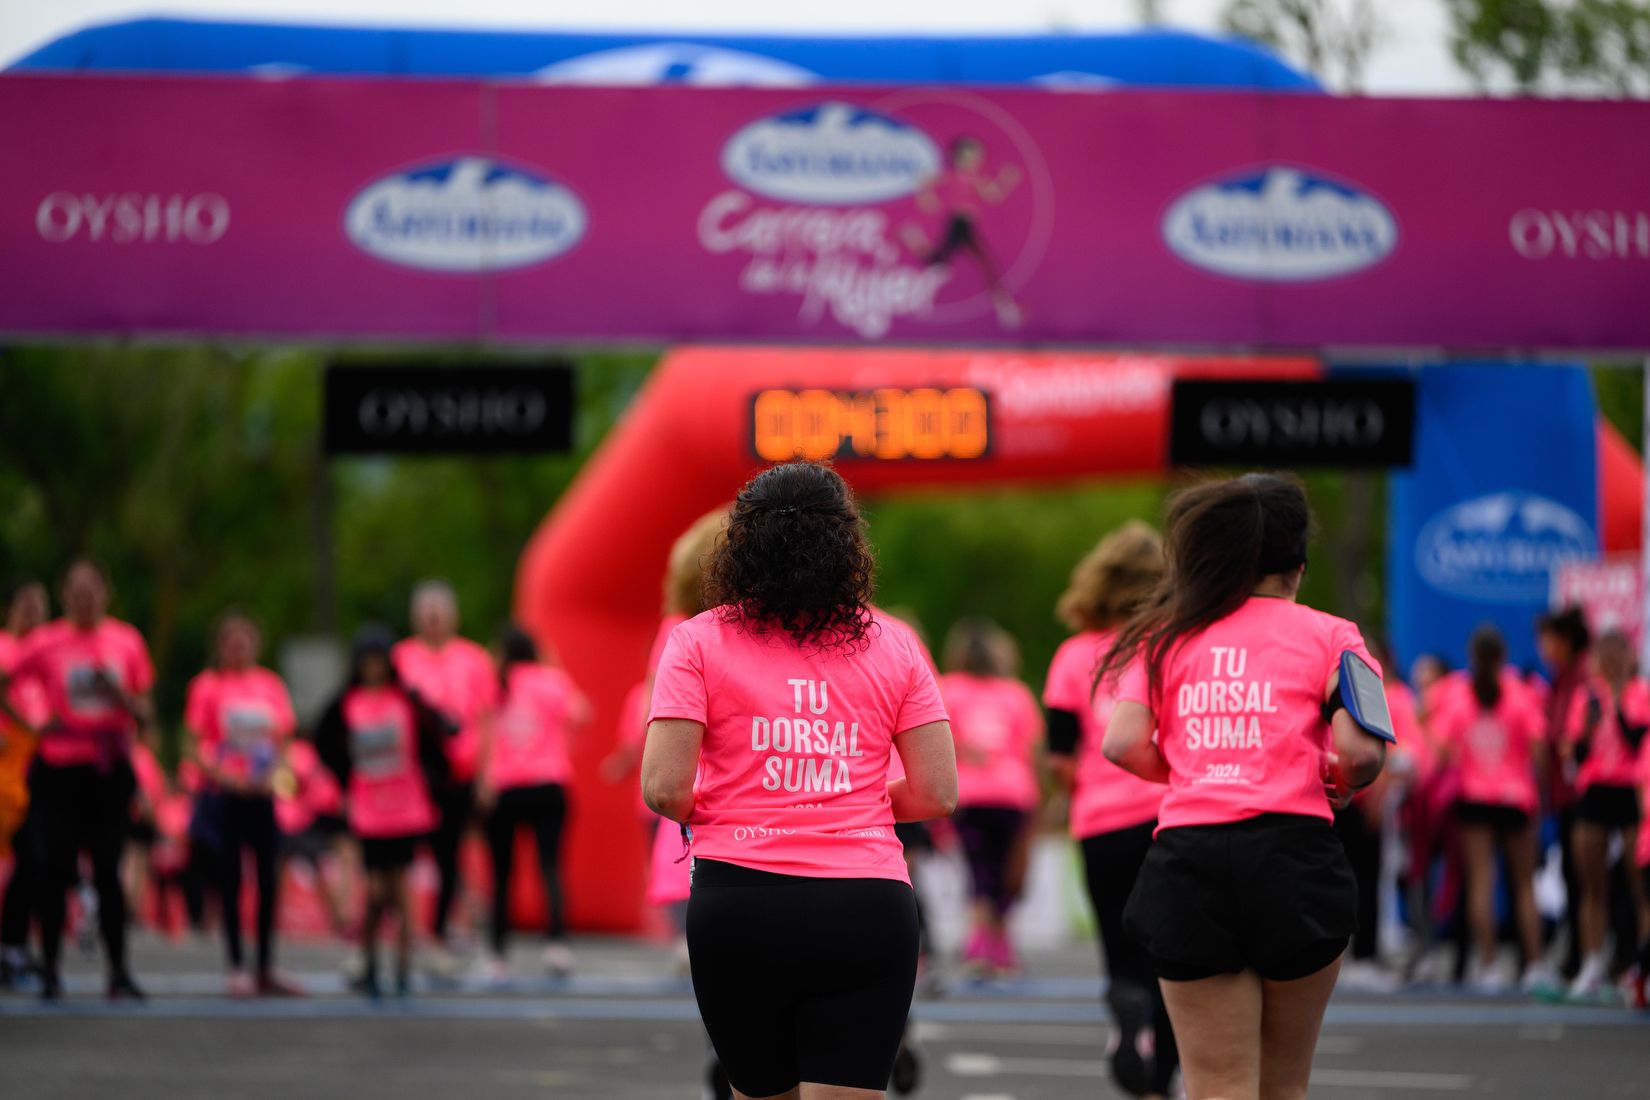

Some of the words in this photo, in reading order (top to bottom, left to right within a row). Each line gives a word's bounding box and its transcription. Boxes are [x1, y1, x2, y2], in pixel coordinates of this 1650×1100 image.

[36, 191, 231, 244] OYSHO
[358, 389, 548, 435] OYSHO
[1200, 399, 1385, 447] OYSHO
[1209, 646, 1247, 678] TU
[787, 678, 829, 715] TU
[1177, 680, 1278, 717] DORSAL
[751, 716, 863, 757] DORSAL
[1185, 715, 1263, 750] SUMA
[761, 755, 853, 793] SUMA
[1205, 763, 1241, 778] 2024
